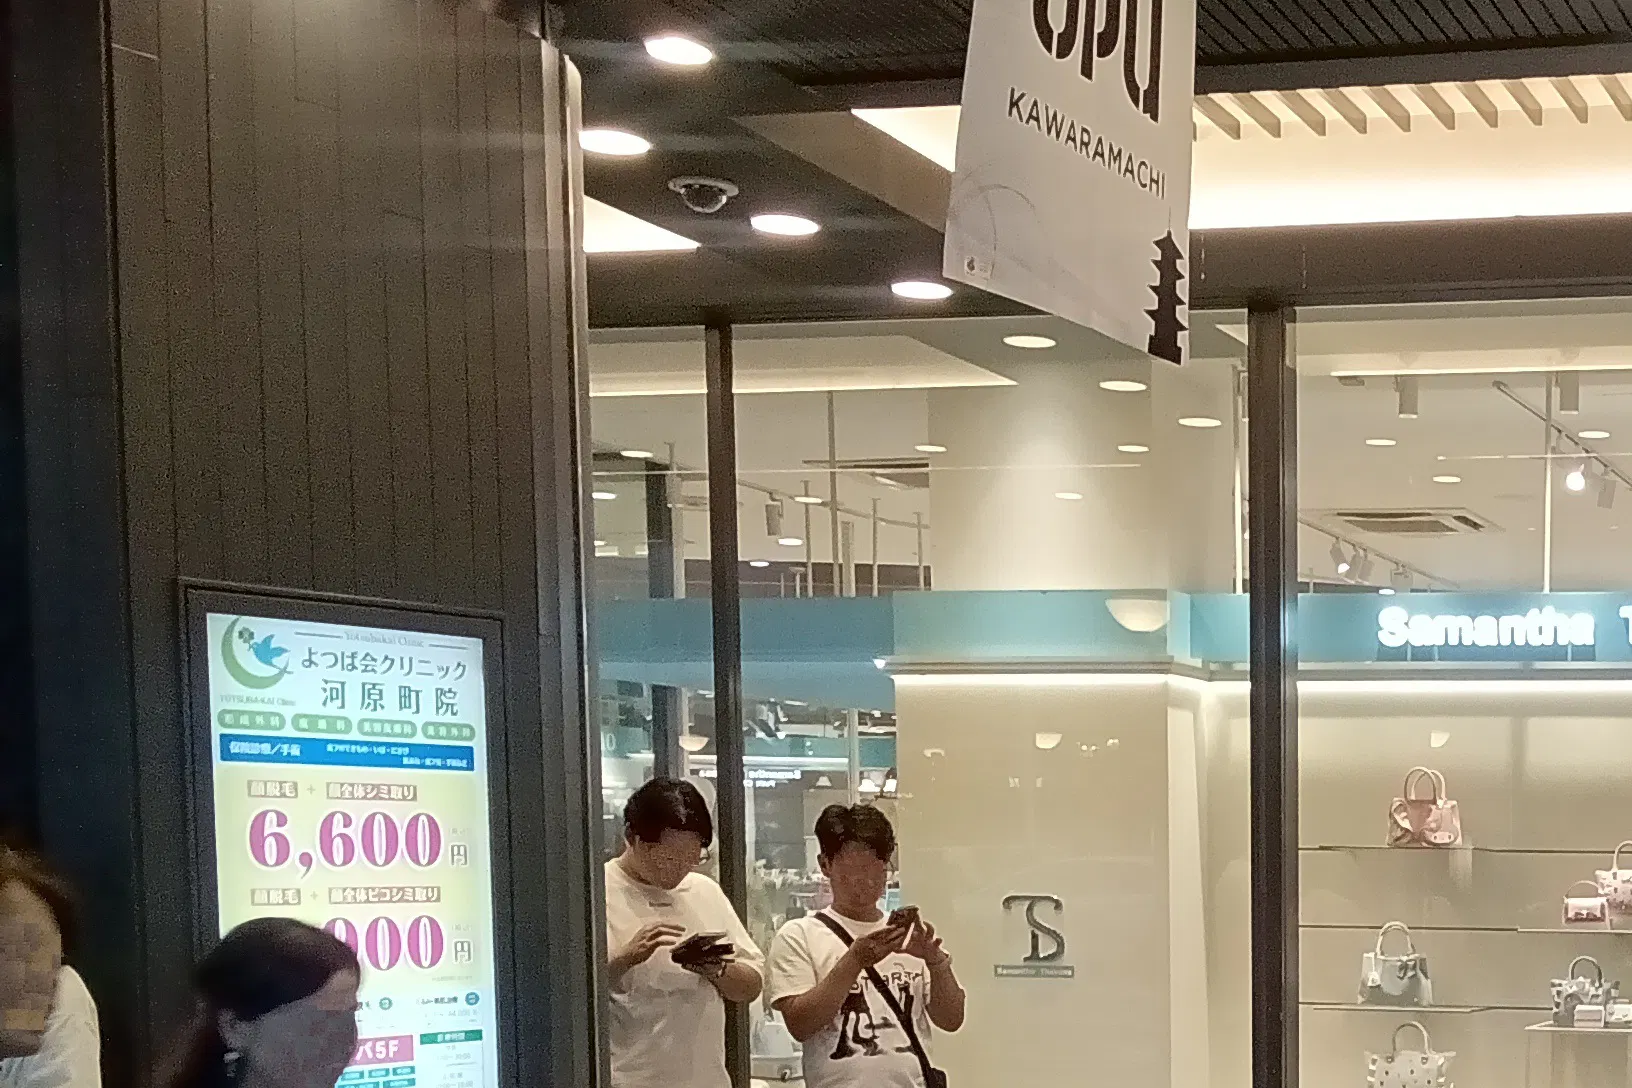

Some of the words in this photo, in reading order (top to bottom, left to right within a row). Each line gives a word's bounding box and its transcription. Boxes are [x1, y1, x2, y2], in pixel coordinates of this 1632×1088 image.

[1007, 86, 1167, 200] KAWARAMACHI
[1377, 605, 1596, 647] Samantha
[300, 646, 468, 681] よつば会クリニック
[321, 678, 459, 717] 河原町院
[249, 808, 442, 880] 6,600
[450, 844, 468, 867] 円
[454, 940, 472, 963] 円
